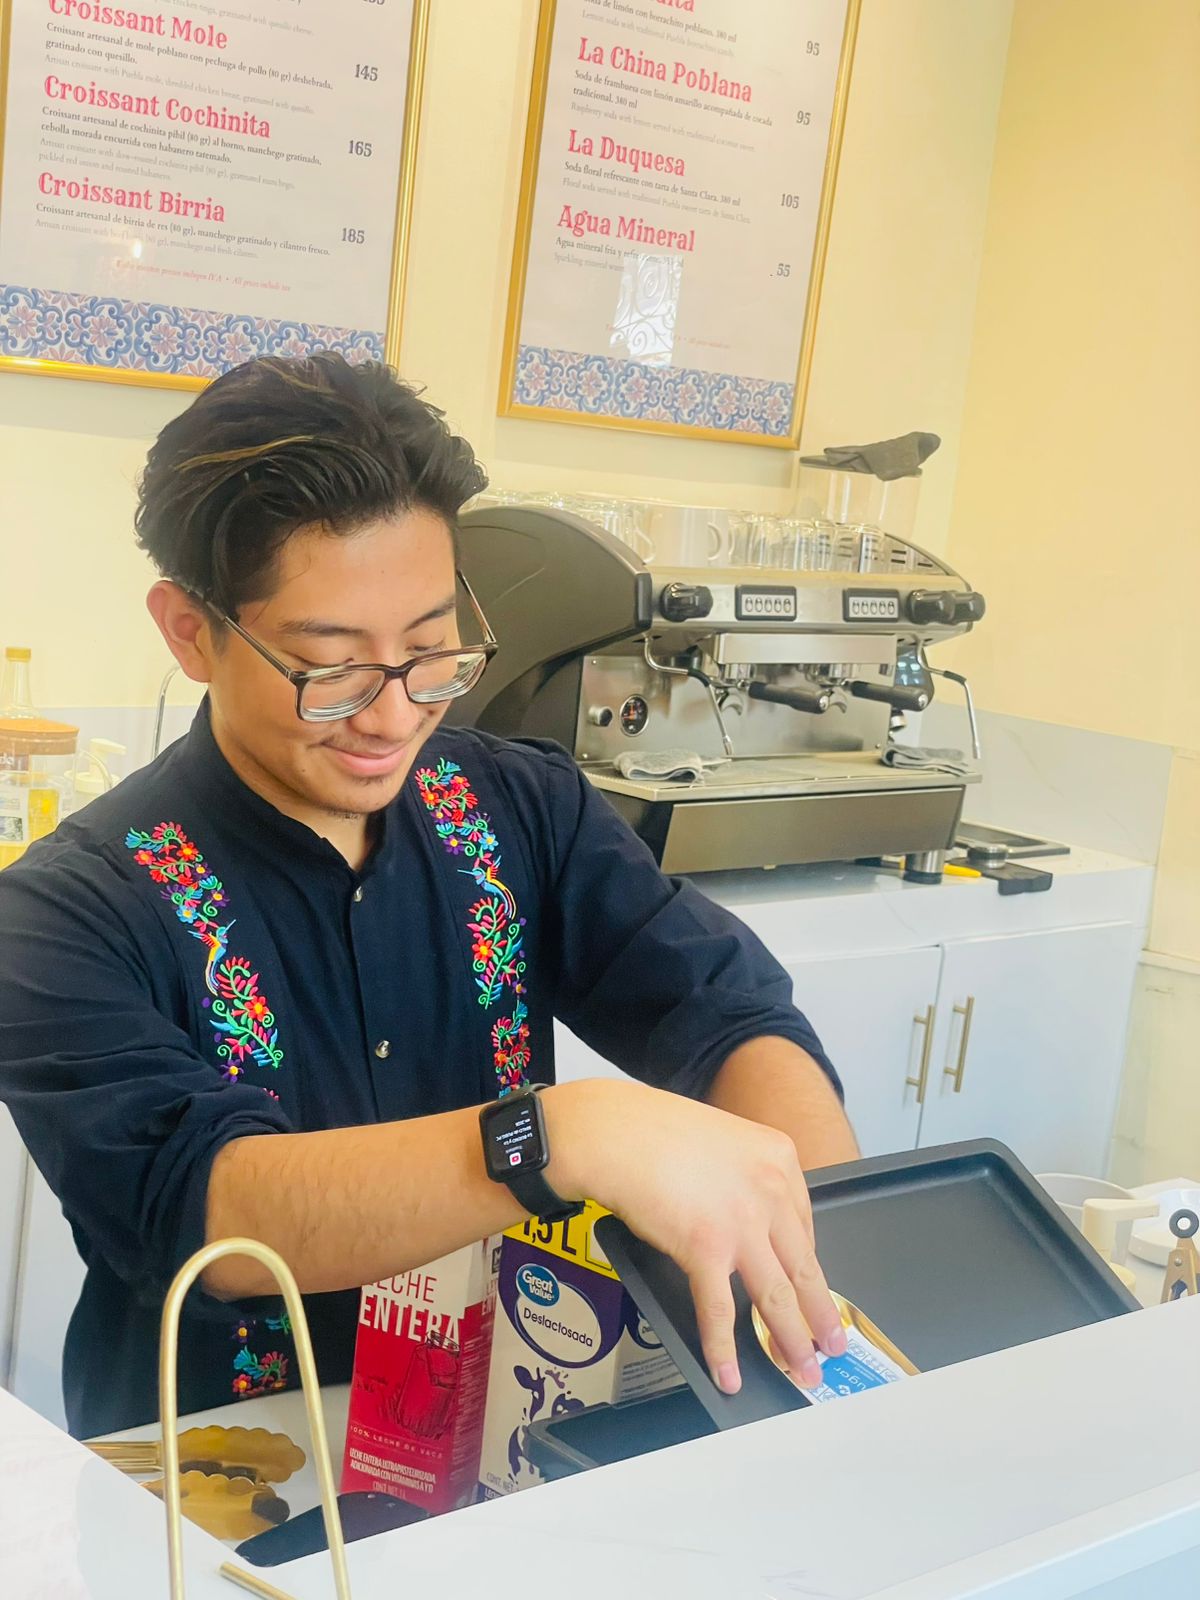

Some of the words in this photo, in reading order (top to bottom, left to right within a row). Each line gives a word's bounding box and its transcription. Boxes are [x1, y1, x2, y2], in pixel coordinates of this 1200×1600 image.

[48, 0, 165, 36] Croissant
[171, 16, 227, 49] Mole
[635, 10, 647, 18] con
[45, 40, 85, 53] gratinado
[87, 48, 102, 56] con
[46, 21, 84, 37] Croissant
[86, 32, 122, 45] artesanal
[124, 37, 133, 47] de
[136, 42, 155, 52] mole
[157, 46, 188, 58] poblano
[205, 56, 235, 70] pechuga
[238, 60, 246, 70] de
[248, 64, 266, 75] pollo
[806, 40, 820, 57] 95
[354, 63, 378, 81] 145
[575, 69, 591, 81] Soda
[593, 73, 601, 83] de
[640, 88, 651, 96] con
[578, 37, 604, 65] La
[611, 45, 667, 82] China
[671, 61, 752, 103] Poblana
[44, 74, 160, 117] Croissant
[165, 98, 270, 138] Cochinita
[628, 99, 637, 108] ml
[796, 110, 811, 126] 95
[41, 122, 69, 134] cebolla
[72, 129, 101, 139] morada
[103, 135, 140, 146] encurtida
[159, 141, 194, 156] habanero
[42, 106, 80, 120] Croissant
[82, 116, 117, 127] artesanal
[119, 119, 128, 129] de
[130, 123, 166, 135] cochinita
[168, 129, 185, 139] pibil
[200, 135, 211, 146] gr)
[212, 136, 219, 145] al
[247, 145, 284, 158] manchego
[348, 139, 372, 157] 165
[568, 129, 593, 157] La
[599, 135, 685, 176] Duquesa
[565, 160, 581, 172] Soda
[583, 164, 602, 176] floral
[670, 183, 678, 193] de
[680, 185, 697, 197] Santa
[38, 172, 153, 210] Croissant
[158, 191, 225, 222] Birria
[780, 193, 800, 209] 105
[36, 202, 73, 216] Croissant
[76, 211, 110, 222] artesanal
[112, 214, 121, 223] de
[123, 215, 144, 227] birria
[146, 219, 156, 228] de
[197, 229, 235, 242] manchego
[237, 235, 271, 245] gratinado
[279, 239, 306, 250] cilantro
[342, 227, 365, 244] 185
[557, 204, 611, 238] Agua
[616, 215, 695, 252] Mineral
[556, 236, 574, 248] Agua
[576, 242, 603, 252] mineral
[776, 262, 791, 278] 55
[561, 1218, 577, 1256] L
[367, 1271, 437, 1304] CHE
[522, 1269, 553, 1294] Great
[529, 1283, 555, 1301] Value
[360, 1290, 463, 1352] ENTERA
[523, 1307, 593, 1347] Deslactosada
[373, 1434, 400, 1448] LECHE
